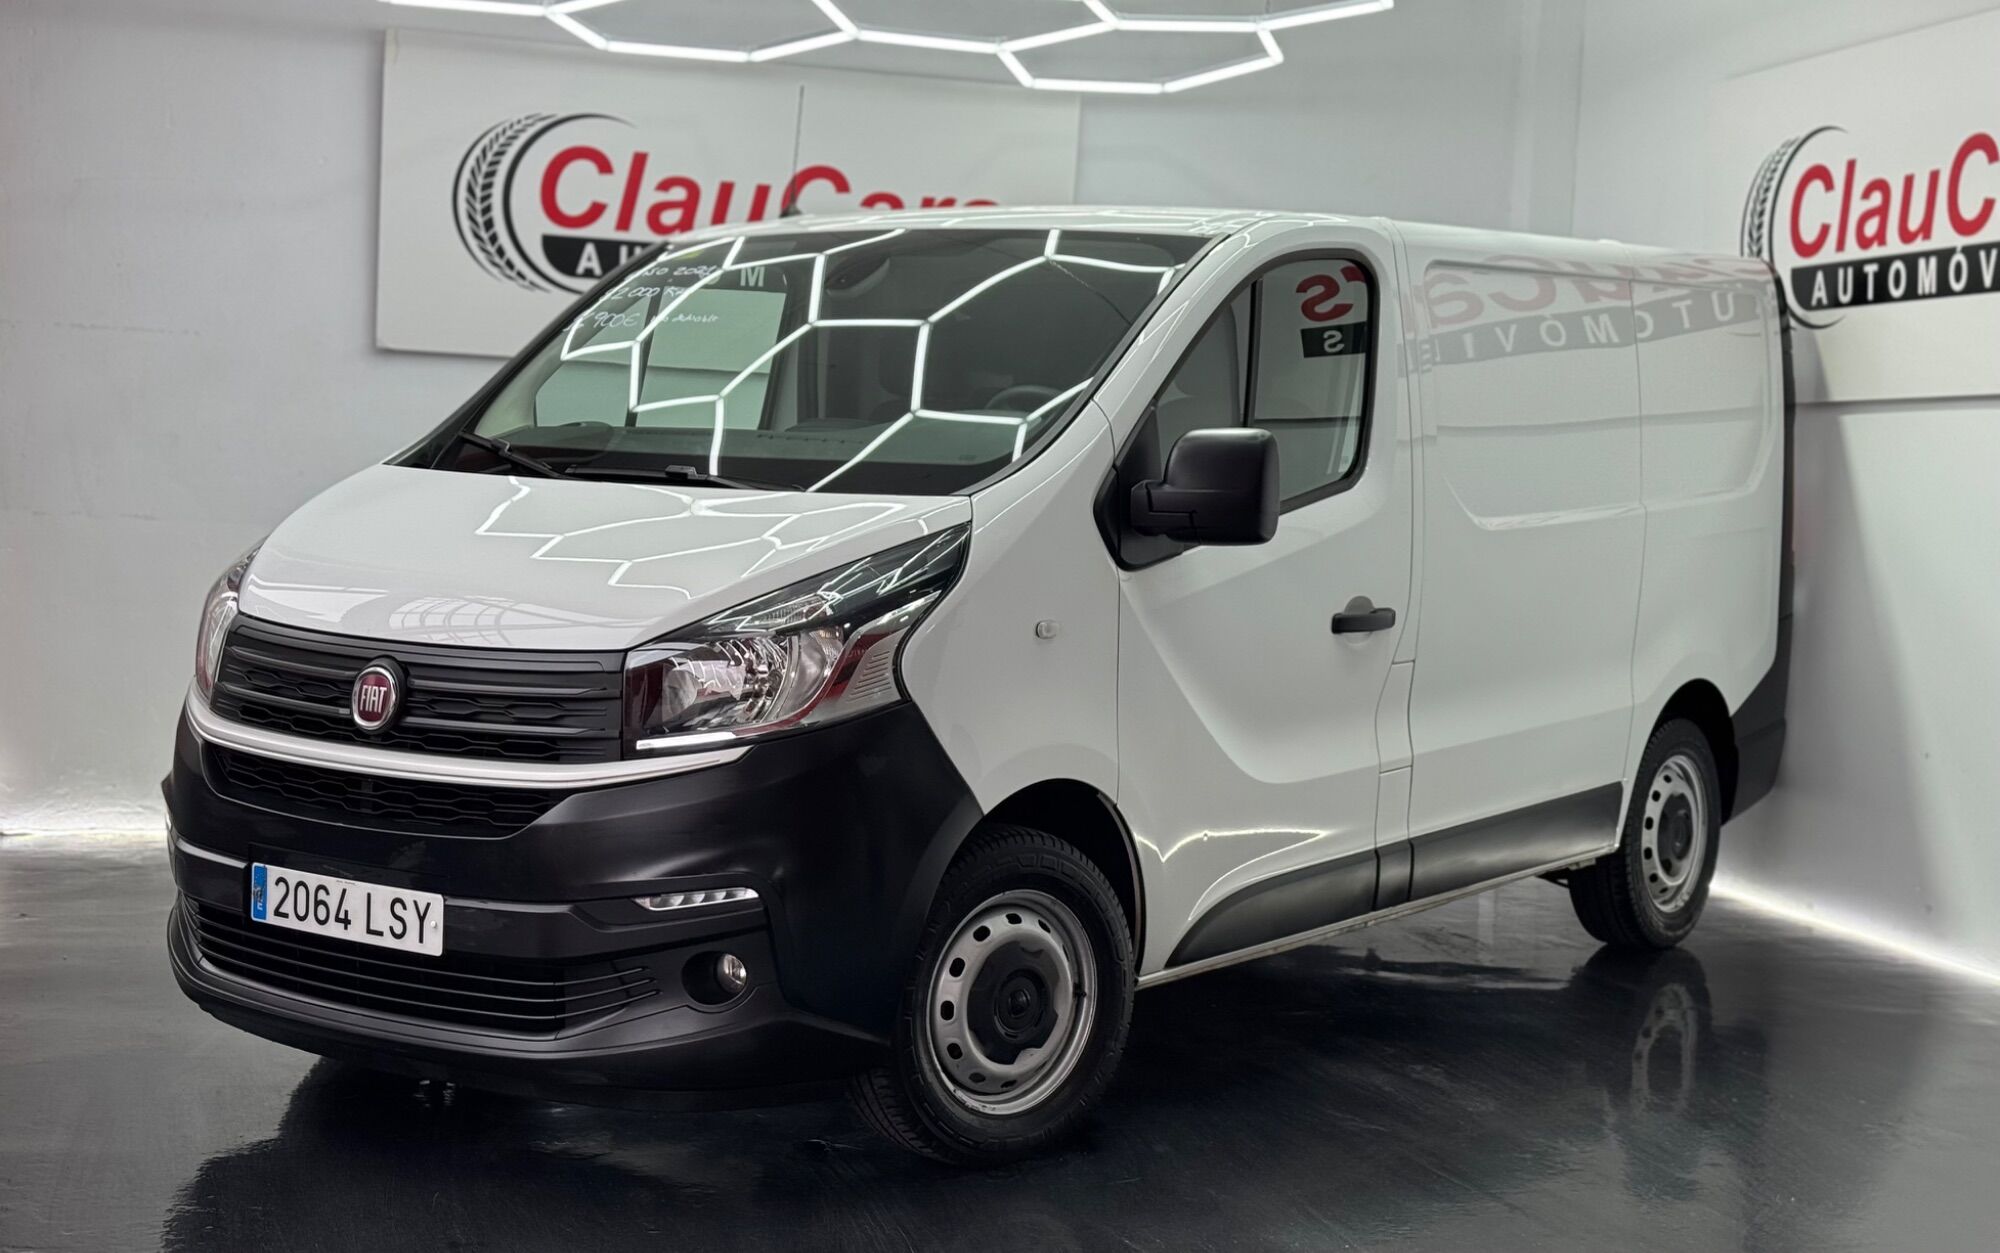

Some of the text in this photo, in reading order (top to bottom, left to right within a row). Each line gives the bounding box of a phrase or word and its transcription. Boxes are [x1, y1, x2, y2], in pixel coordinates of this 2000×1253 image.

[360, 685, 387, 713] FIAT
[273, 876, 432, 944] 2064 LSY
